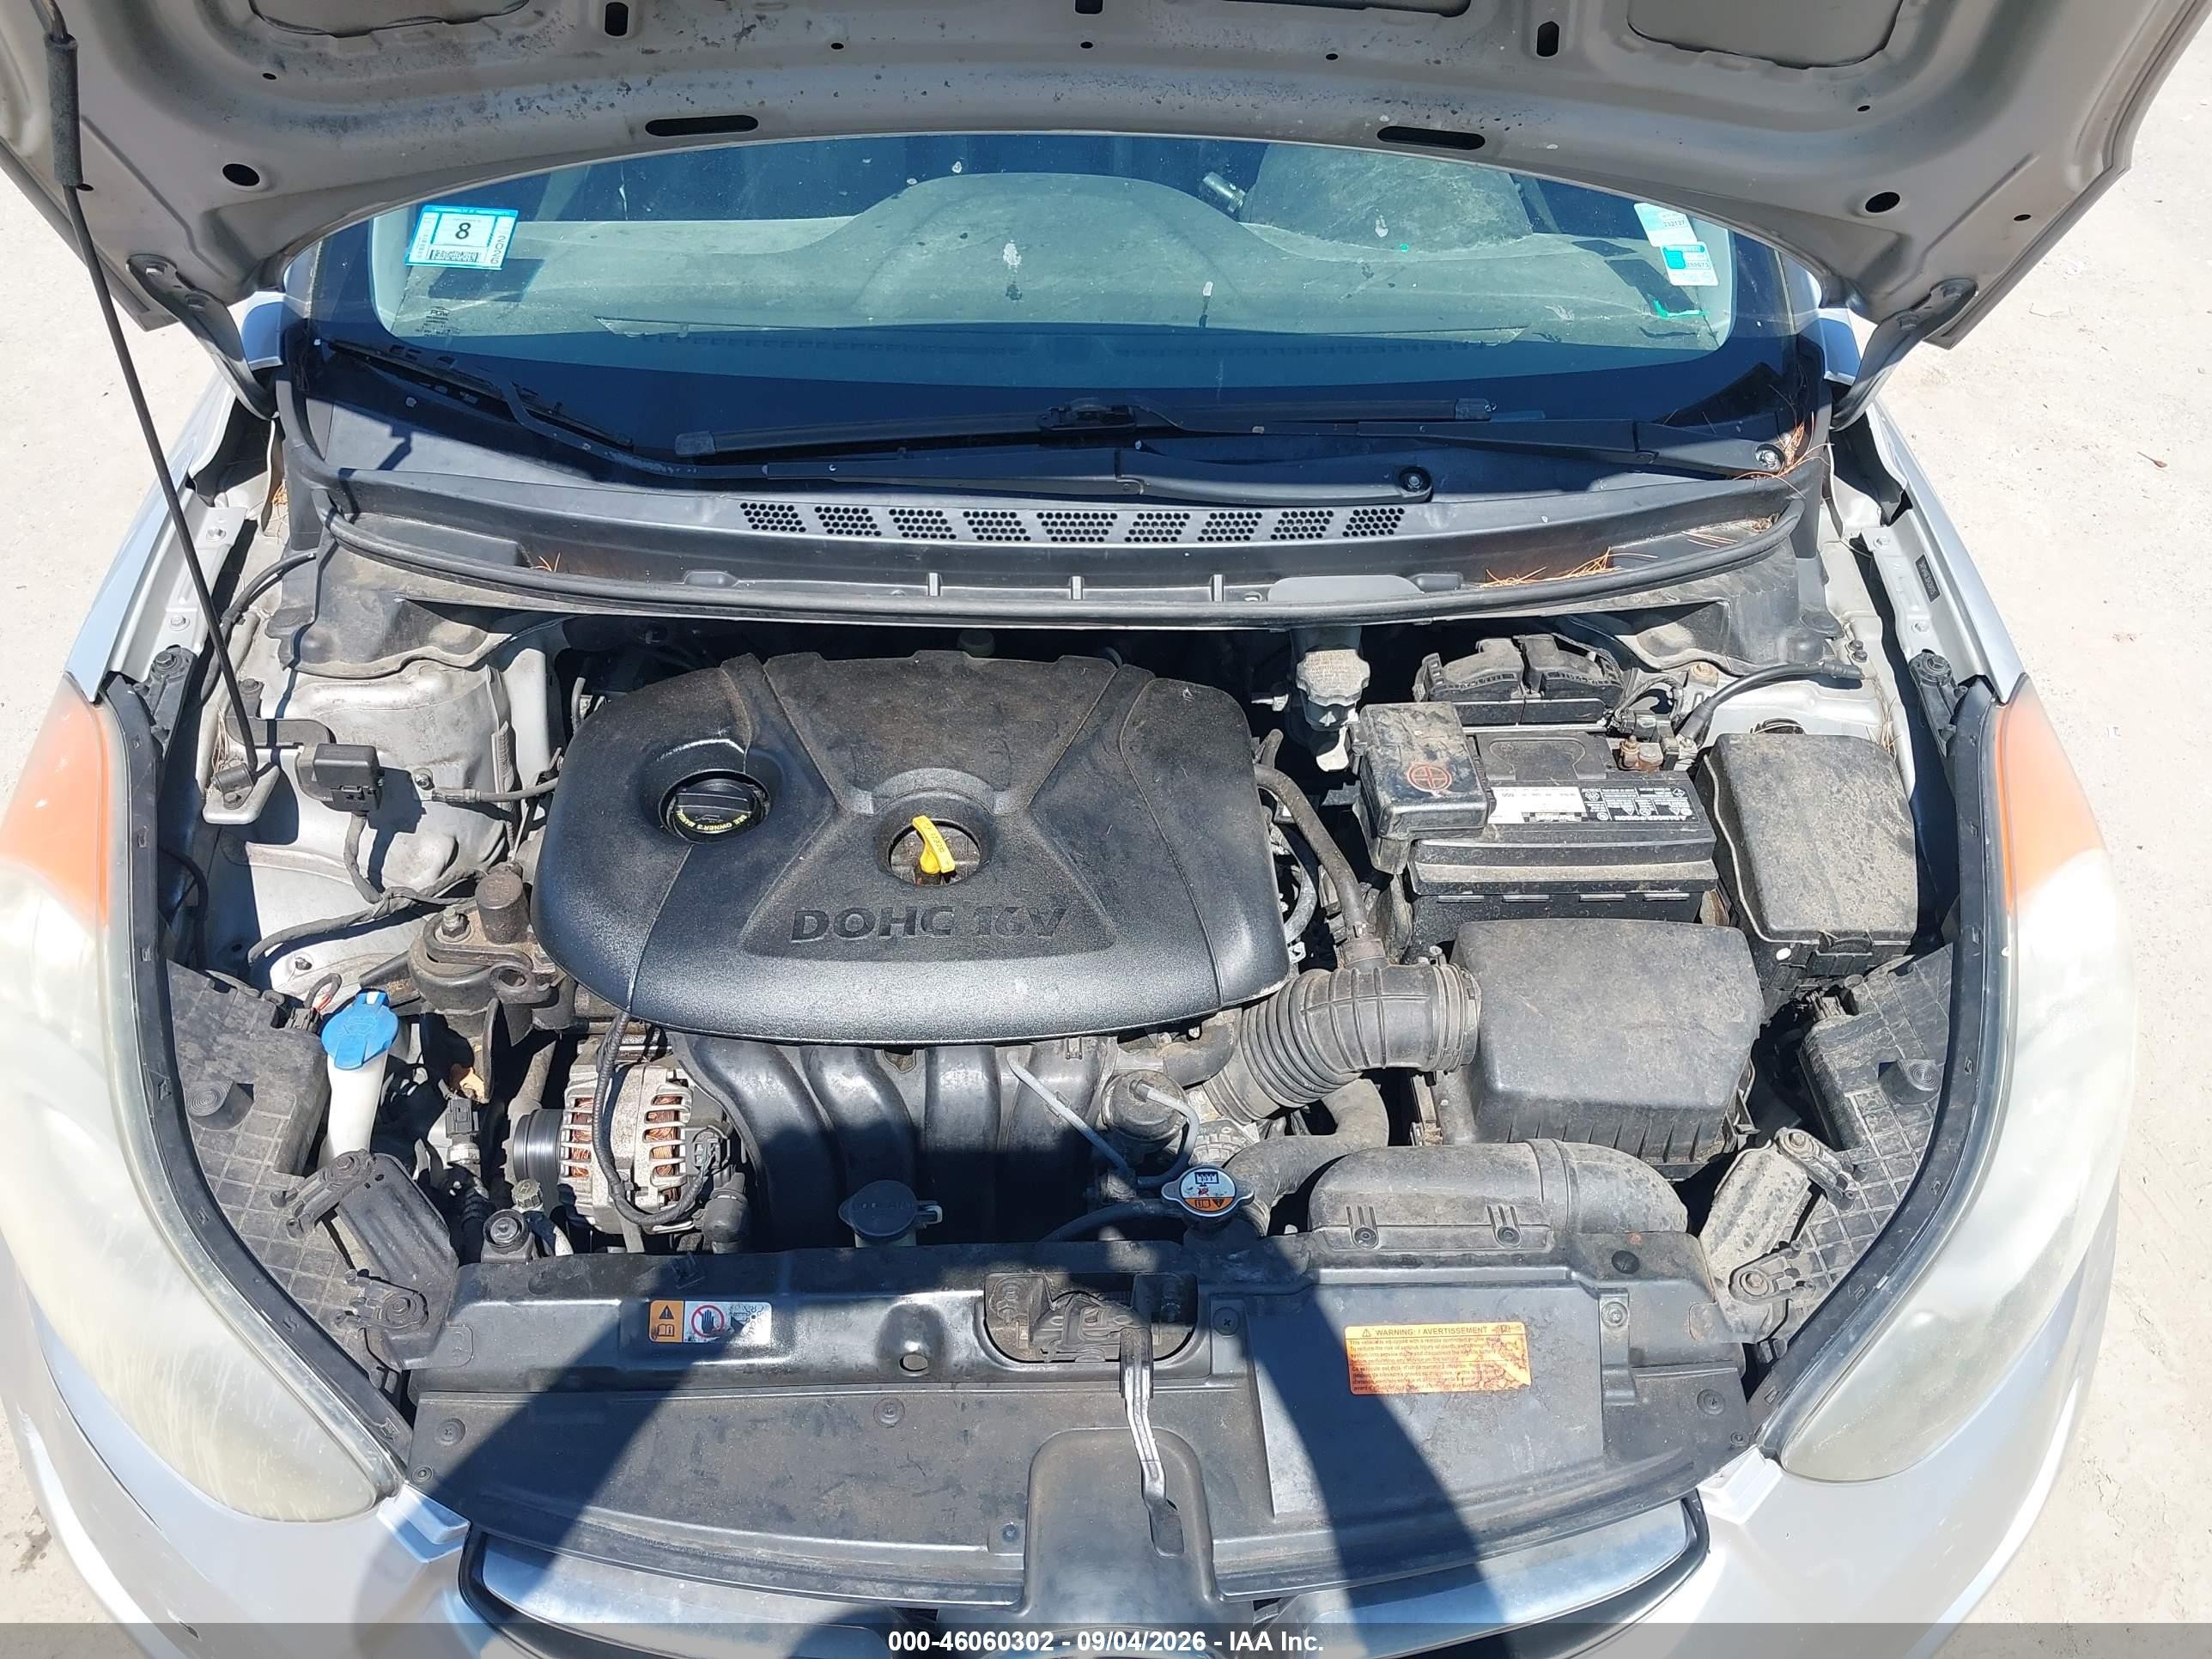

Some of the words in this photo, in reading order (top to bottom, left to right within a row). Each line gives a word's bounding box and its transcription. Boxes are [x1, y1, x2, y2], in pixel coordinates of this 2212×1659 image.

[455, 222, 471, 240] 8
[489, 235, 507, 264] 2026
[696, 822, 733, 831] OWNER'S
[791, 905, 955, 943] DOHC
[973, 905, 1069, 939] 16V
[1422, 1326, 1488, 1335] AVERTISSEMENT
